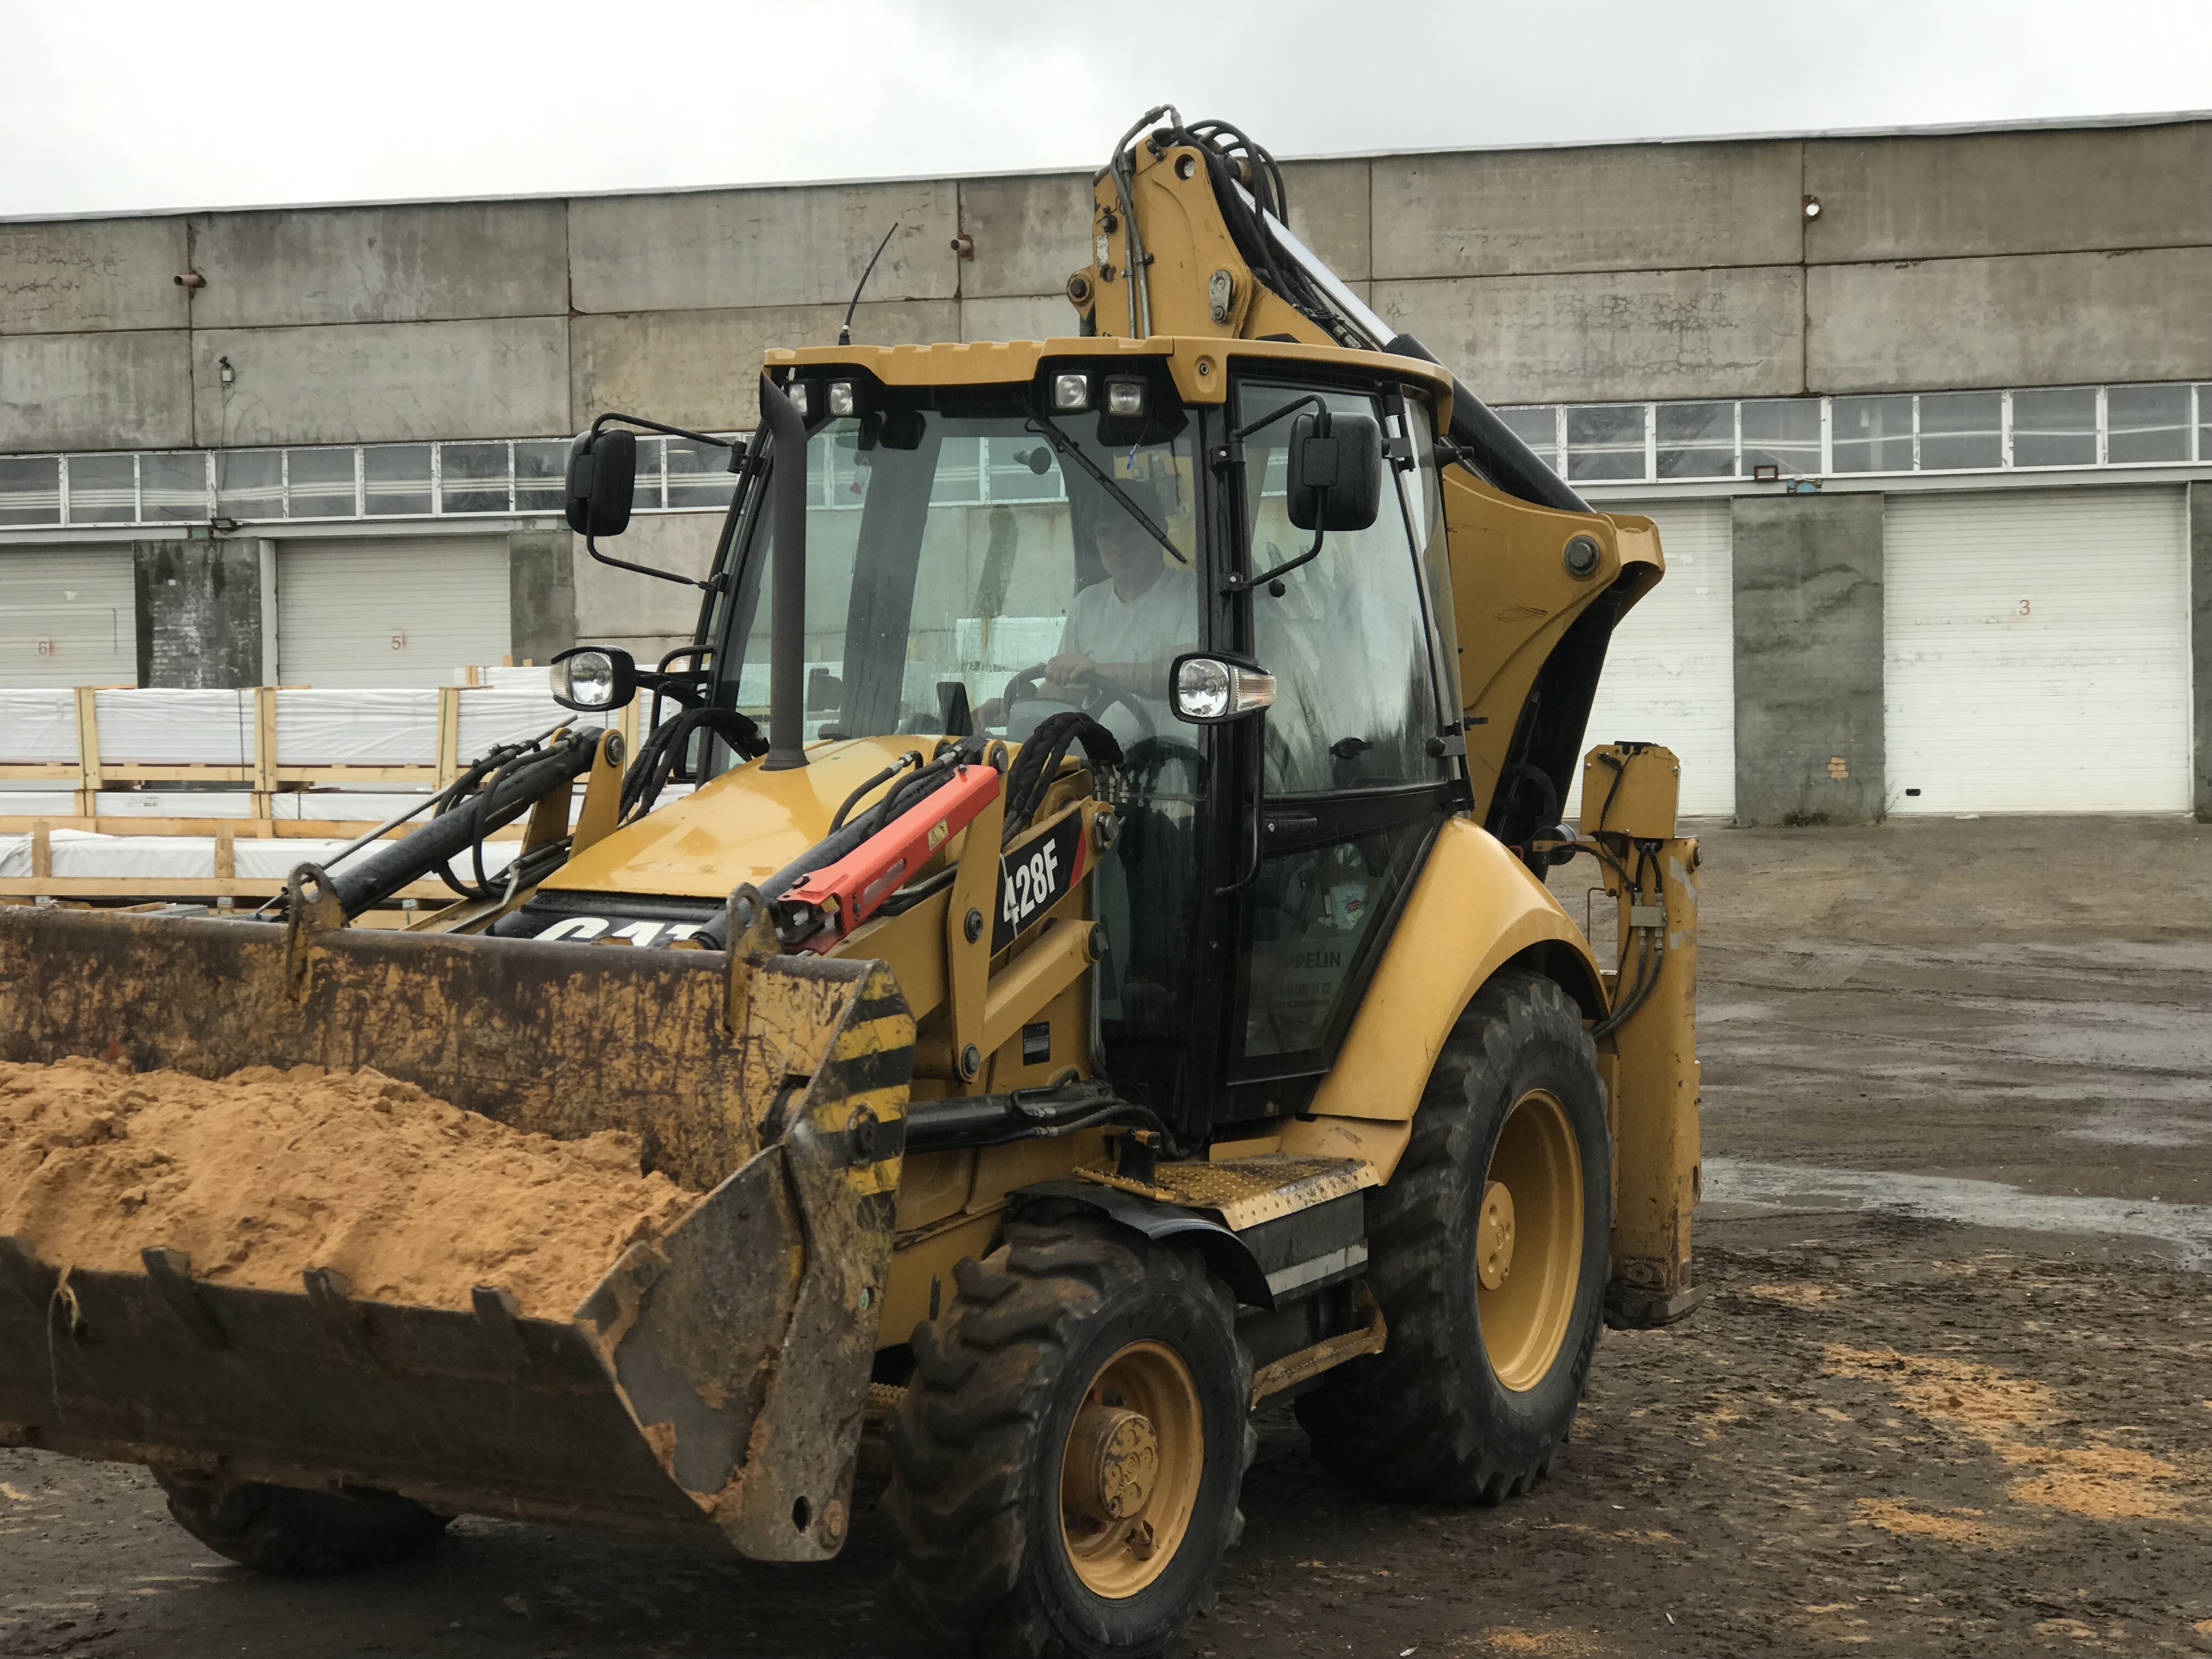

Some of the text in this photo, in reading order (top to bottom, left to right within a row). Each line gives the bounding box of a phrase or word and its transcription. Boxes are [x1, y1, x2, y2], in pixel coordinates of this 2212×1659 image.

[2019, 600, 2030, 615] 3
[38, 641, 47, 655] 6
[392, 636, 401, 650] 5
[1003, 838, 1058, 924] 428F
